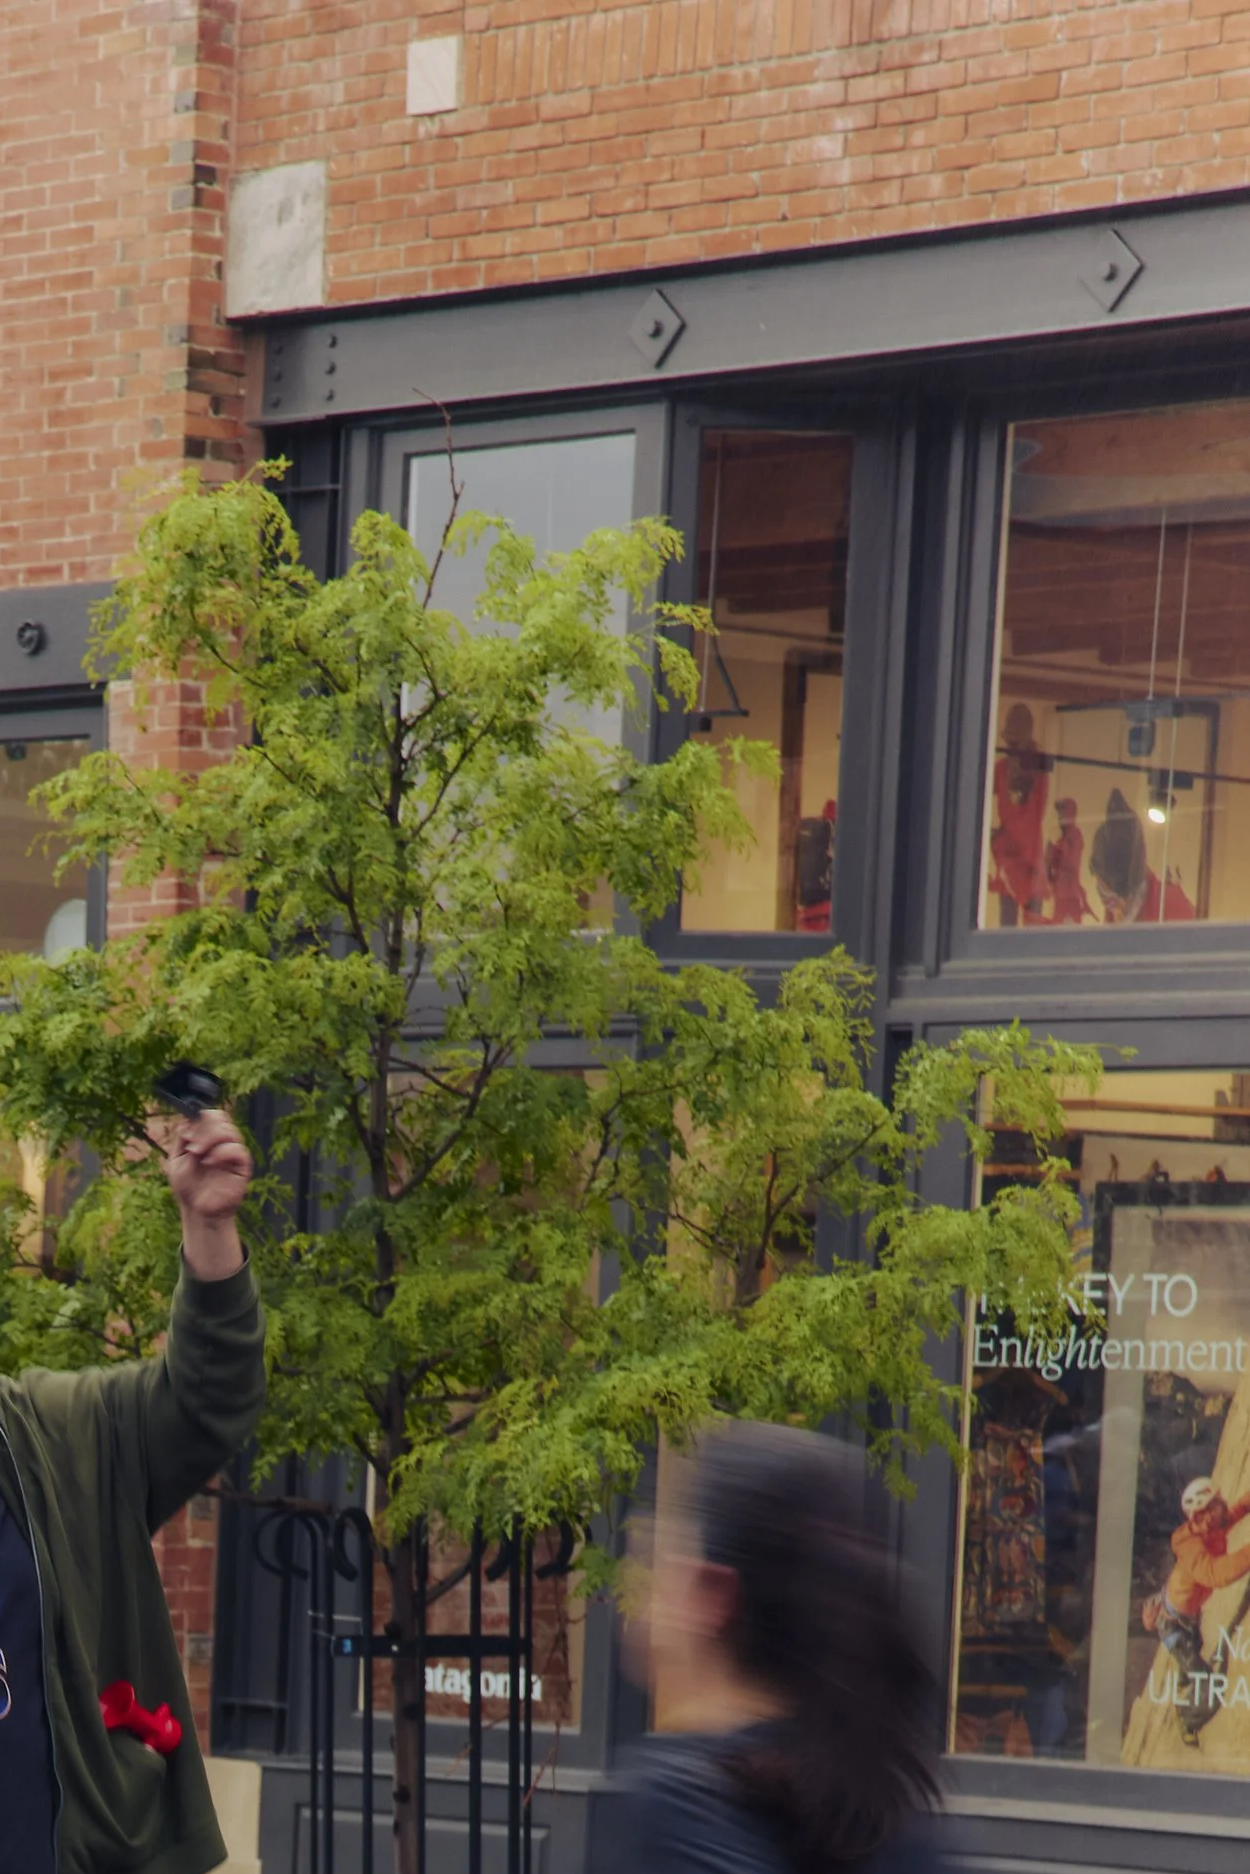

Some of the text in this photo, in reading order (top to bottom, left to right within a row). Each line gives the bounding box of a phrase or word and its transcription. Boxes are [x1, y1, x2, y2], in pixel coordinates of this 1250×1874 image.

[1057, 1272, 1135, 1316] KEY
[1142, 1273, 1198, 1318] TO
[972, 1323, 1248, 1382] Enlightenment
[424, 1663, 543, 1705] atagonia
[1148, 1669, 1250, 1709] ULTRA
